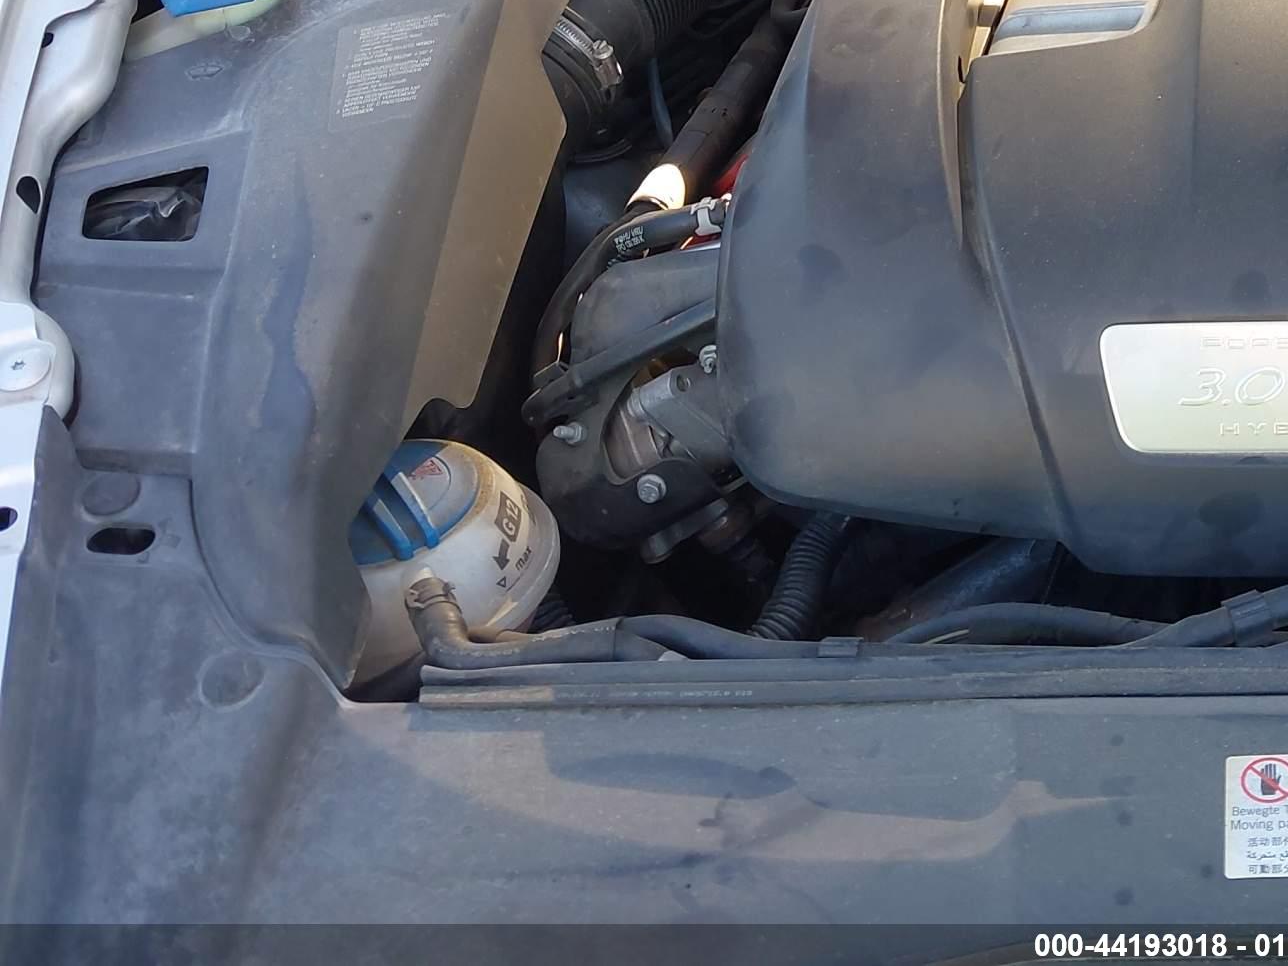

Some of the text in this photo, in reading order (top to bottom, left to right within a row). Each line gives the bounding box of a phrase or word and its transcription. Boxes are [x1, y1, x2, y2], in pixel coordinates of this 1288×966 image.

[1177, 365, 1287, 407] 3.0
[515, 546, 532, 572] max
[1231, 806, 1280, 817] Bewegte
[1230, 819, 1274, 831] Moving
